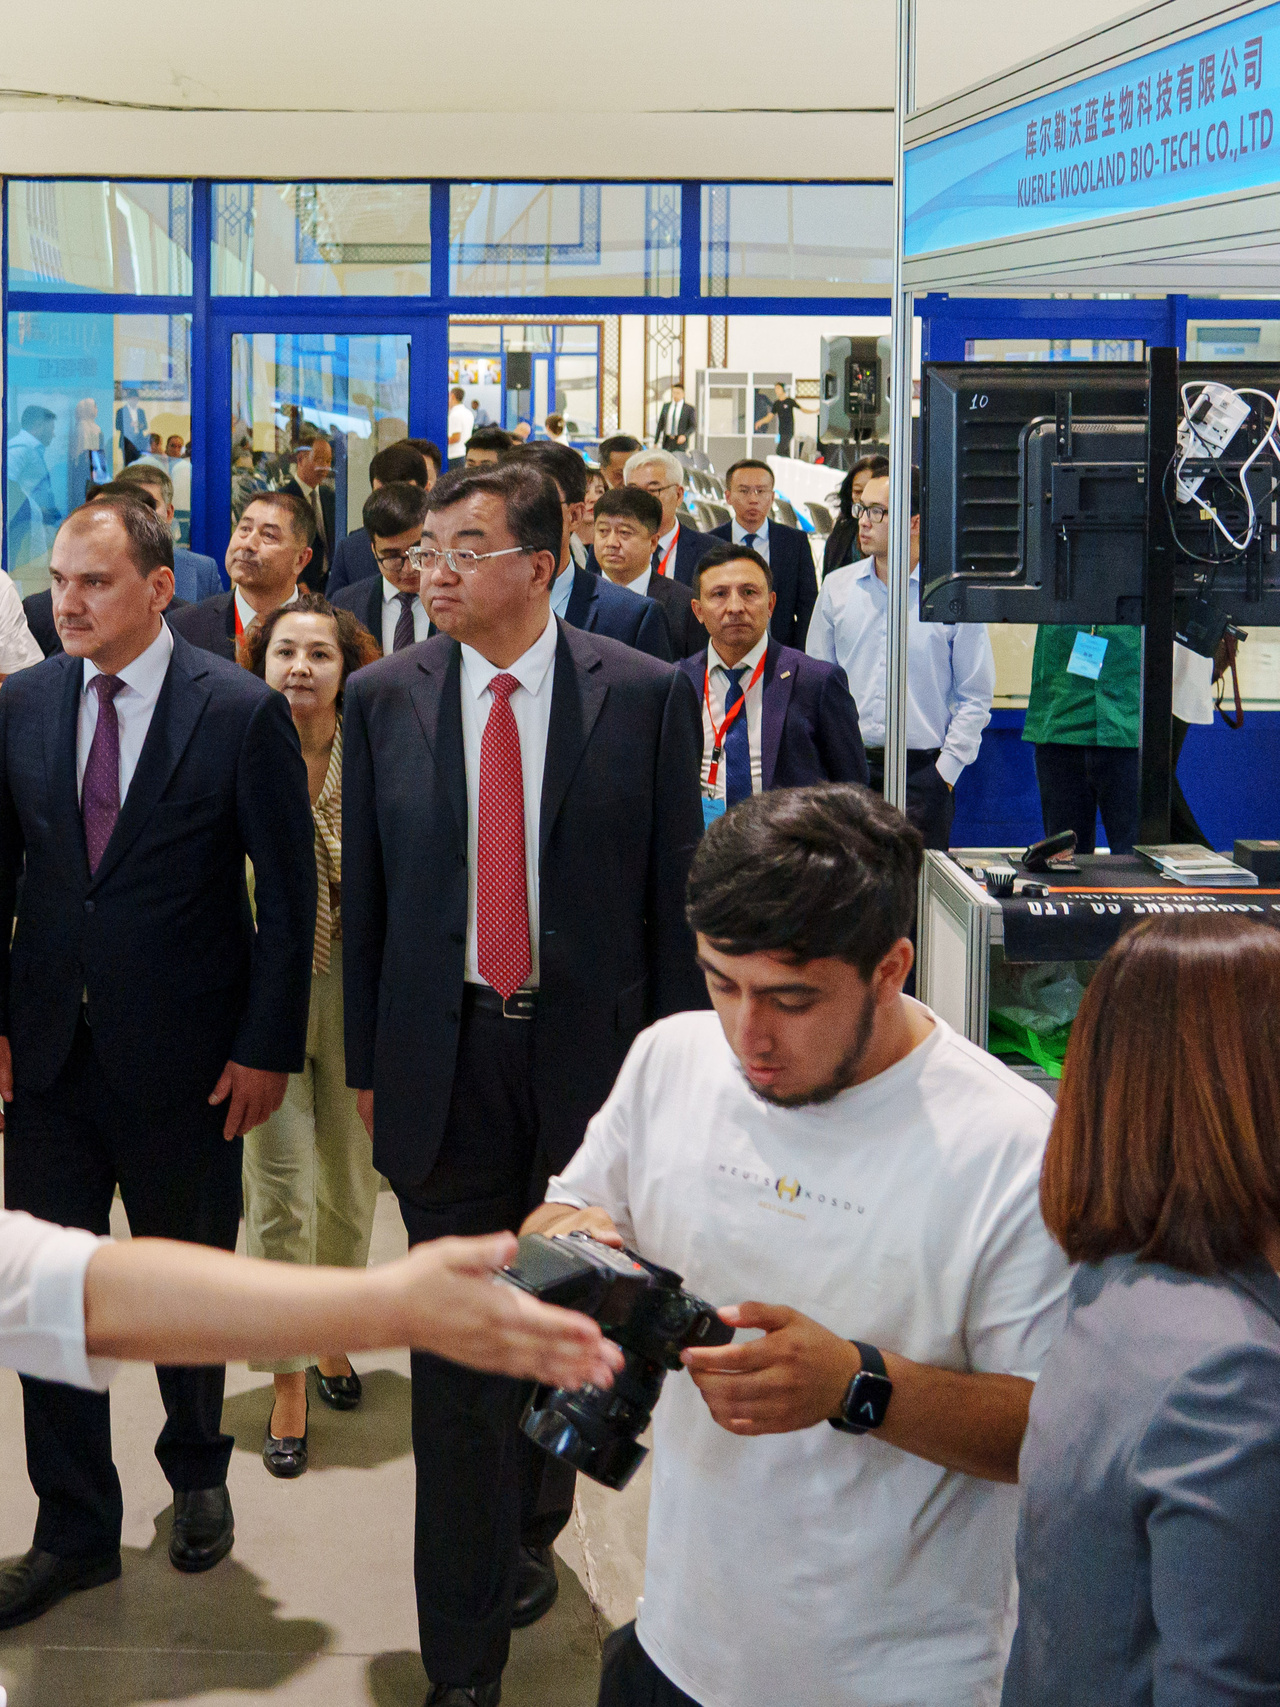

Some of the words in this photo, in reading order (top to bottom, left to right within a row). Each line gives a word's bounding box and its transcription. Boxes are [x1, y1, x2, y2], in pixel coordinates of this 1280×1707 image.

[1025, 35, 1263, 161] 库尔勒沃蓝生物科技有限公司
[1017, 170, 1056, 209] KUERLE
[1059, 151, 1126, 199] WOOLAND
[1130, 128, 1200, 183] BIO-TECH
[1206, 108, 1274, 163] CO.,LTD
[969, 393, 989, 410] 10
